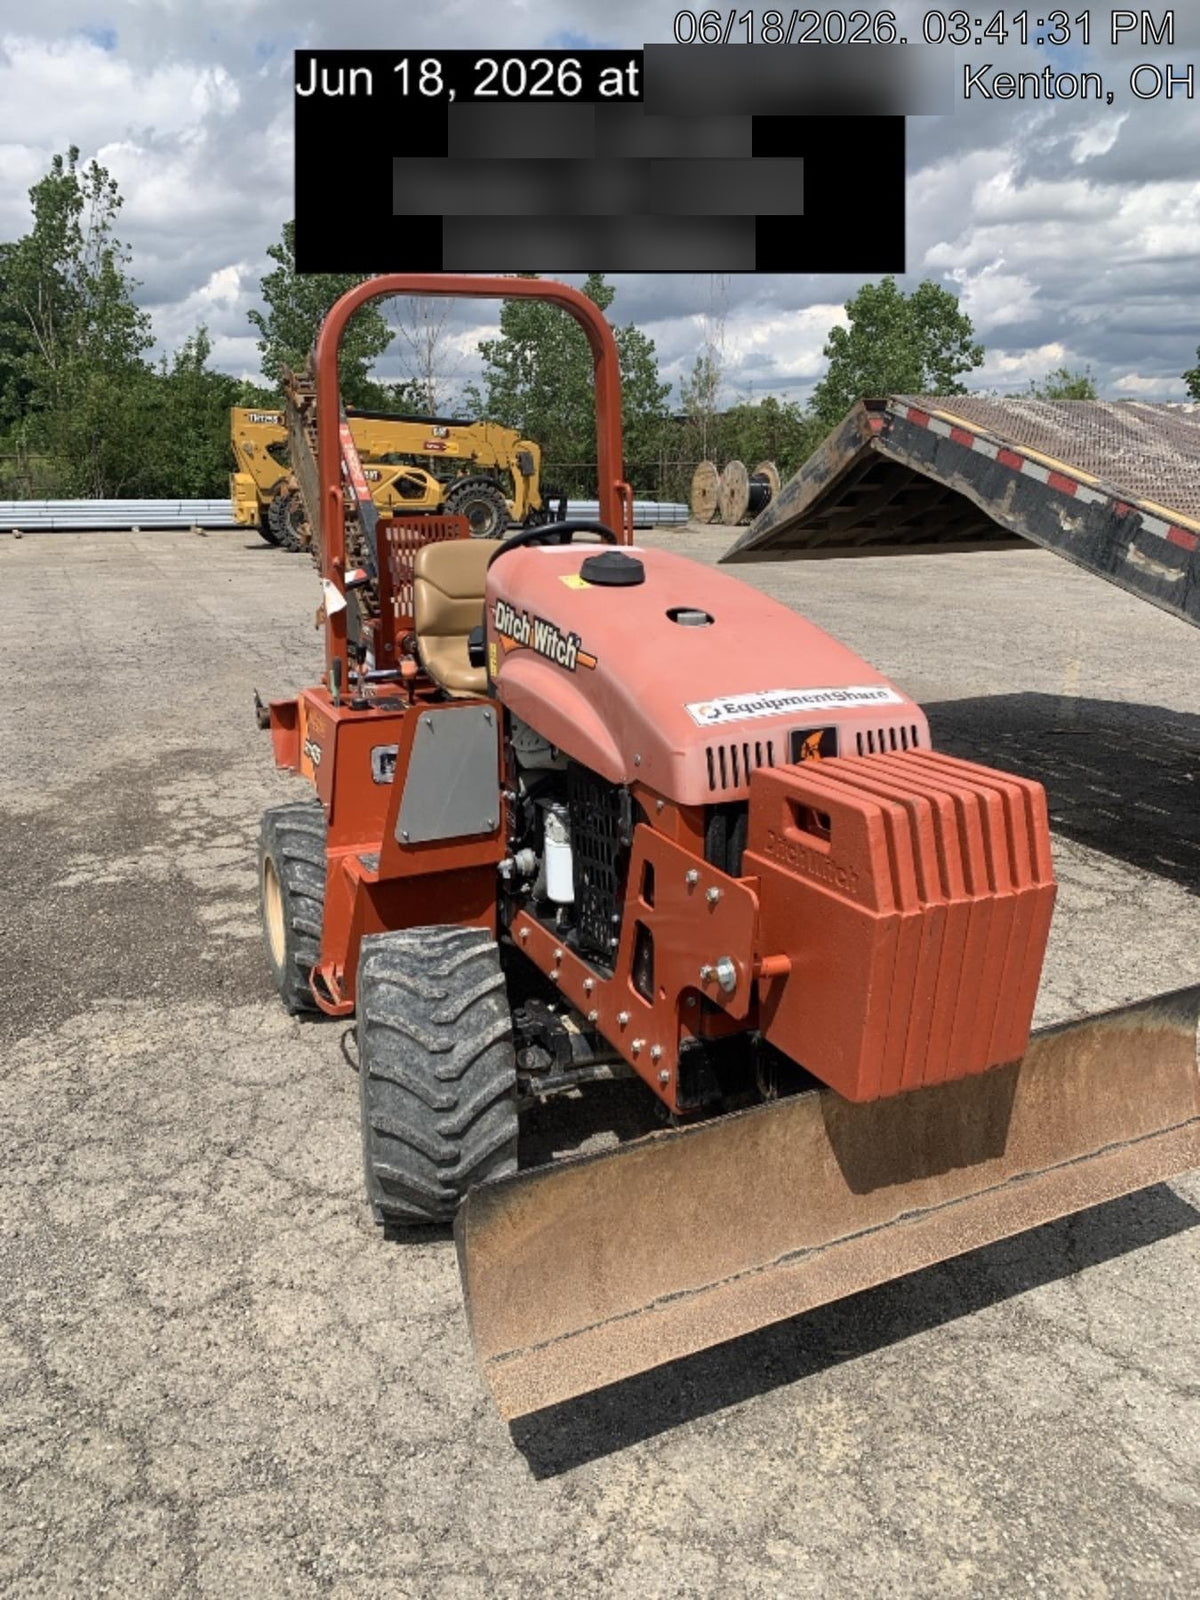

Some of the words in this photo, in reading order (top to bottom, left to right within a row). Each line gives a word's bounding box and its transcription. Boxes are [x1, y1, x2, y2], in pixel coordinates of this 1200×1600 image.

[494, 600, 531, 645] Ditch
[533, 618, 577, 670] Witch
[724, 690, 889, 714] EquipmentShare
